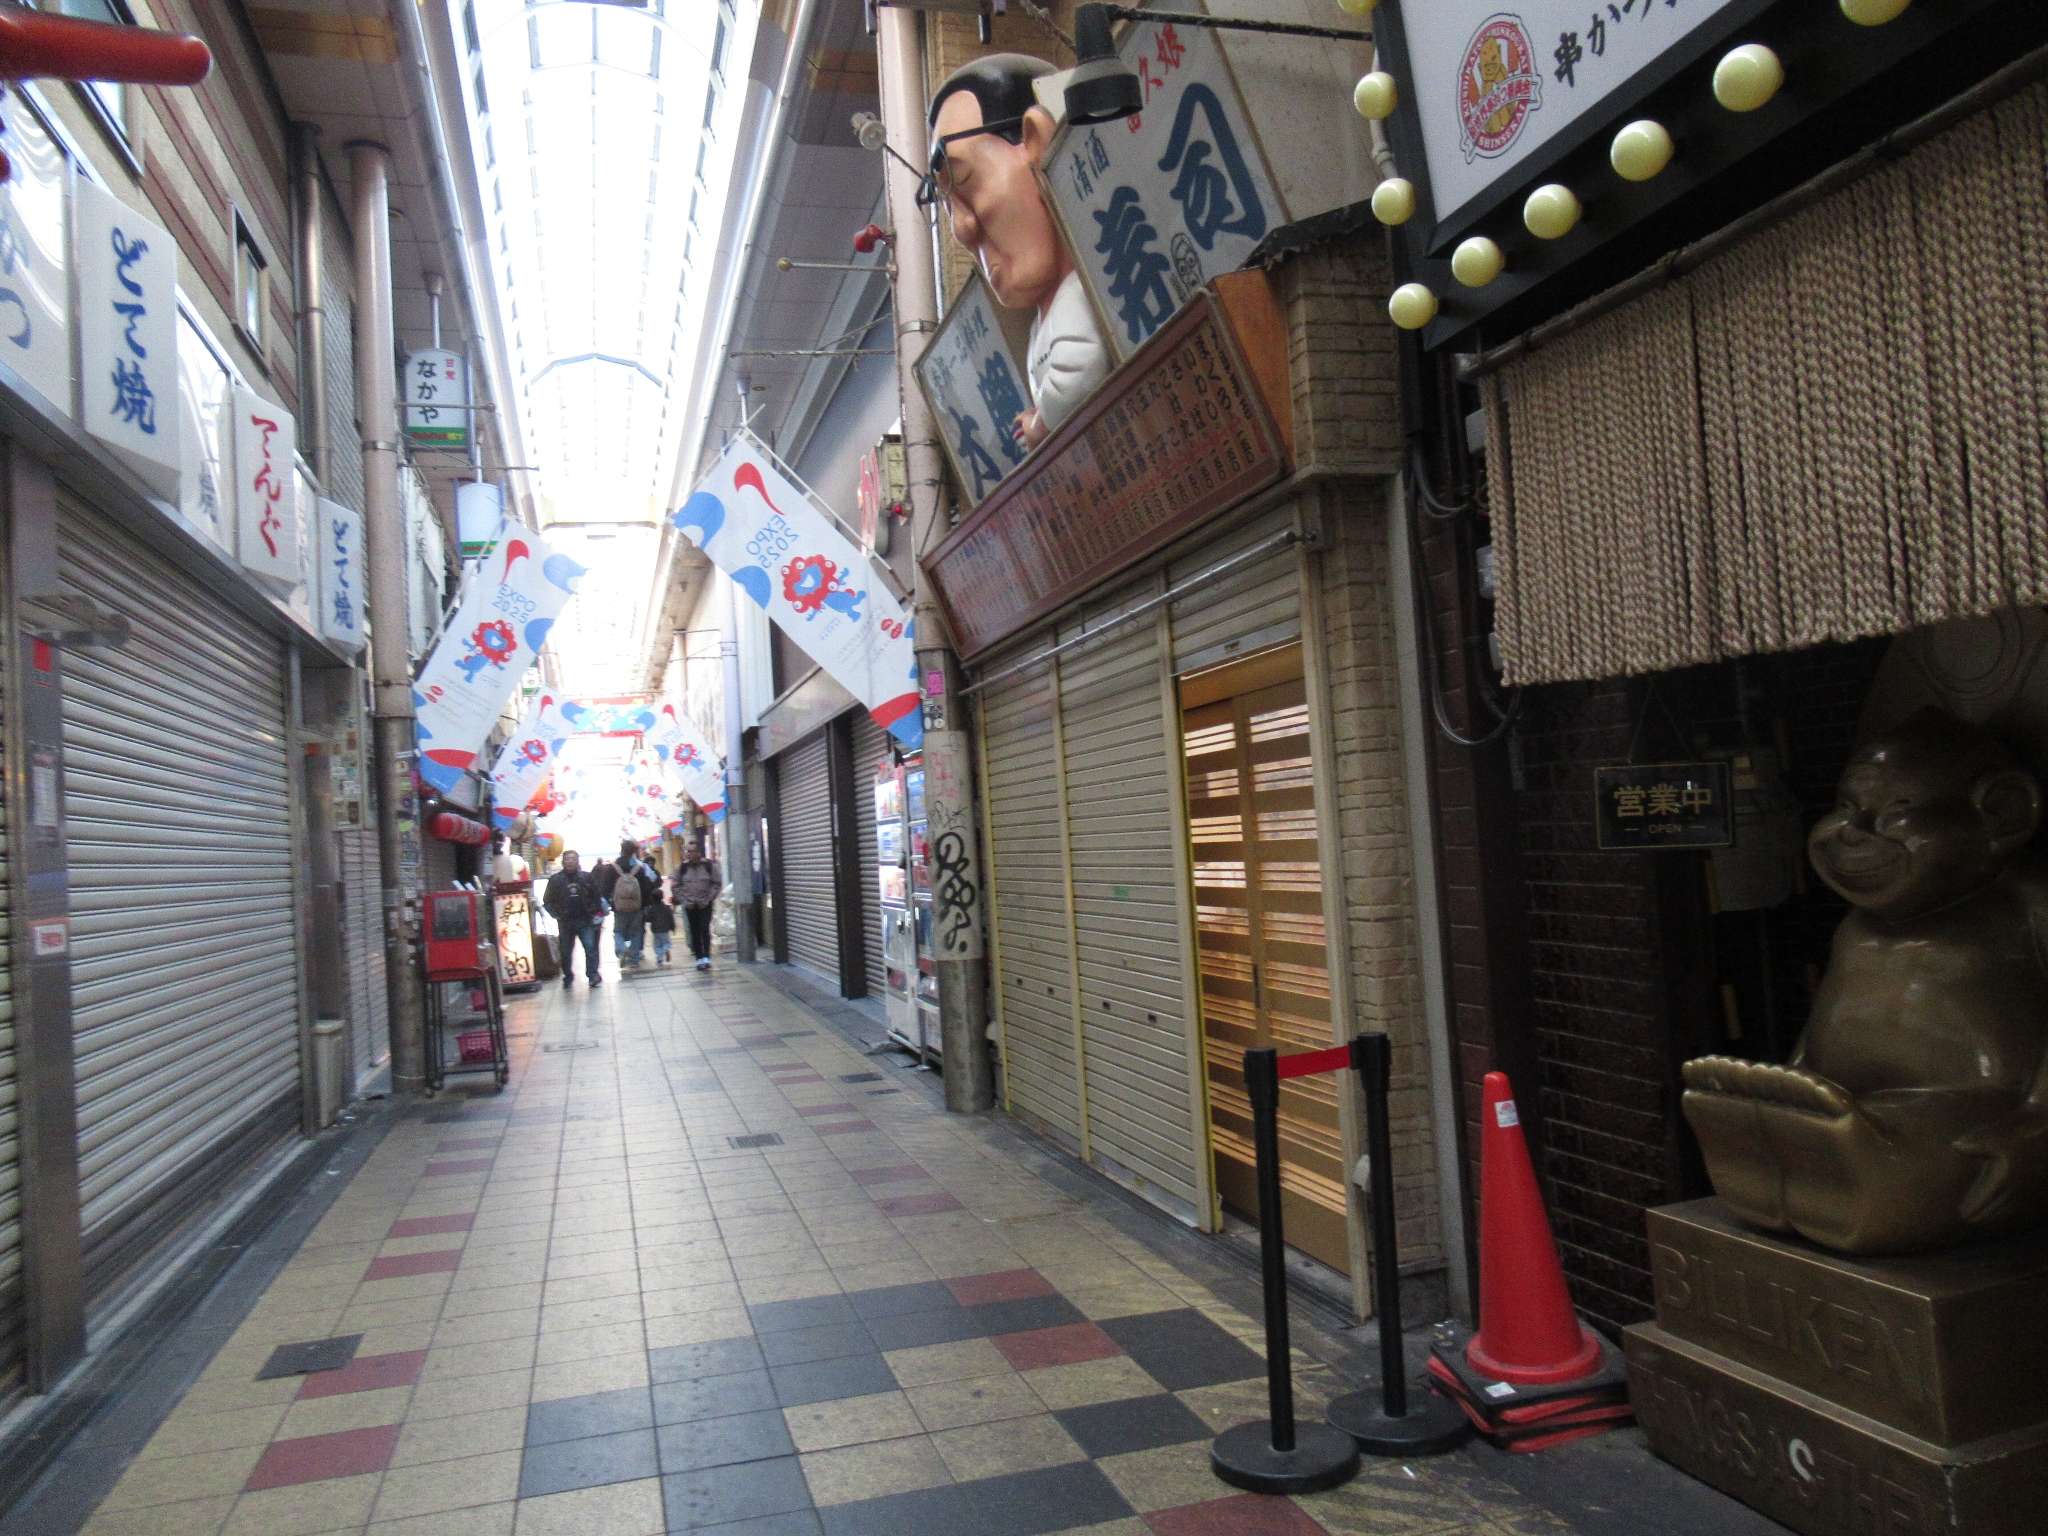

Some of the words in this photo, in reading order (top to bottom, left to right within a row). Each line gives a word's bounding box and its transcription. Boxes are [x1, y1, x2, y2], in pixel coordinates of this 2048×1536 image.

[417, 359, 439, 424] なかや
[497, 583, 537, 613] EXPO
[1613, 783, 1713, 818] 営業中
[1648, 823, 1683, 834] OPEN
[1654, 1241, 1926, 1405] BILLIKEN
